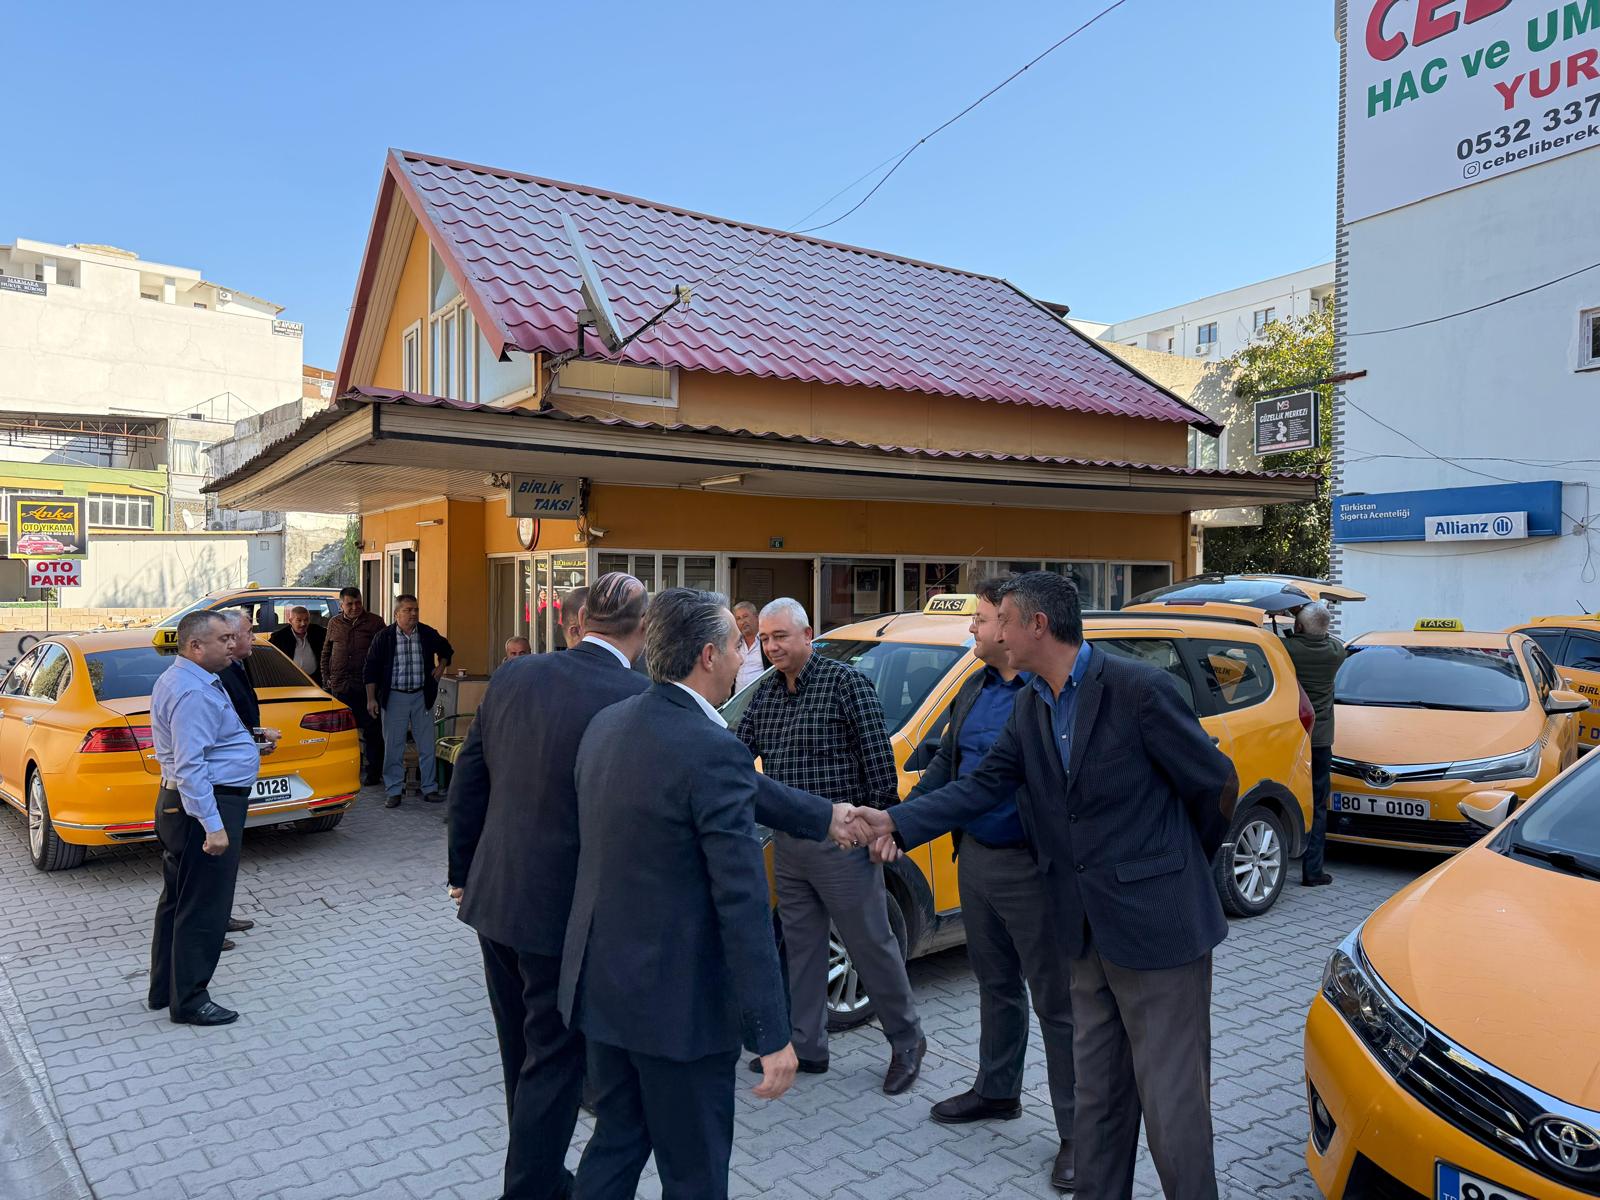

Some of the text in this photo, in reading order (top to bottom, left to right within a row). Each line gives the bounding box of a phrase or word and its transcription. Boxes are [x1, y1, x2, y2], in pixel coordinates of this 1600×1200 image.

[1367, 0, 1600, 118] HAC ve UM
[1493, 48, 1600, 111] YUR
[1456, 94, 1600, 160] 0532 337
[1482, 124, 1600, 170] cebeliberek
[518, 480, 564, 494] BİRLİK
[534, 497, 575, 511] TAKSİ
[1340, 503, 1376, 511] Türkistan
[1339, 509, 1410, 521] Sigorta Acenteliği
[23, 523, 73, 531] OTO YIKAMA
[1434, 521, 1489, 535] Allianz
[36, 561, 73, 573] OTO
[31, 575, 79, 586] PARK
[257, 779, 288, 795] 0128
[1341, 796, 1425, 817] 80 T 0109
